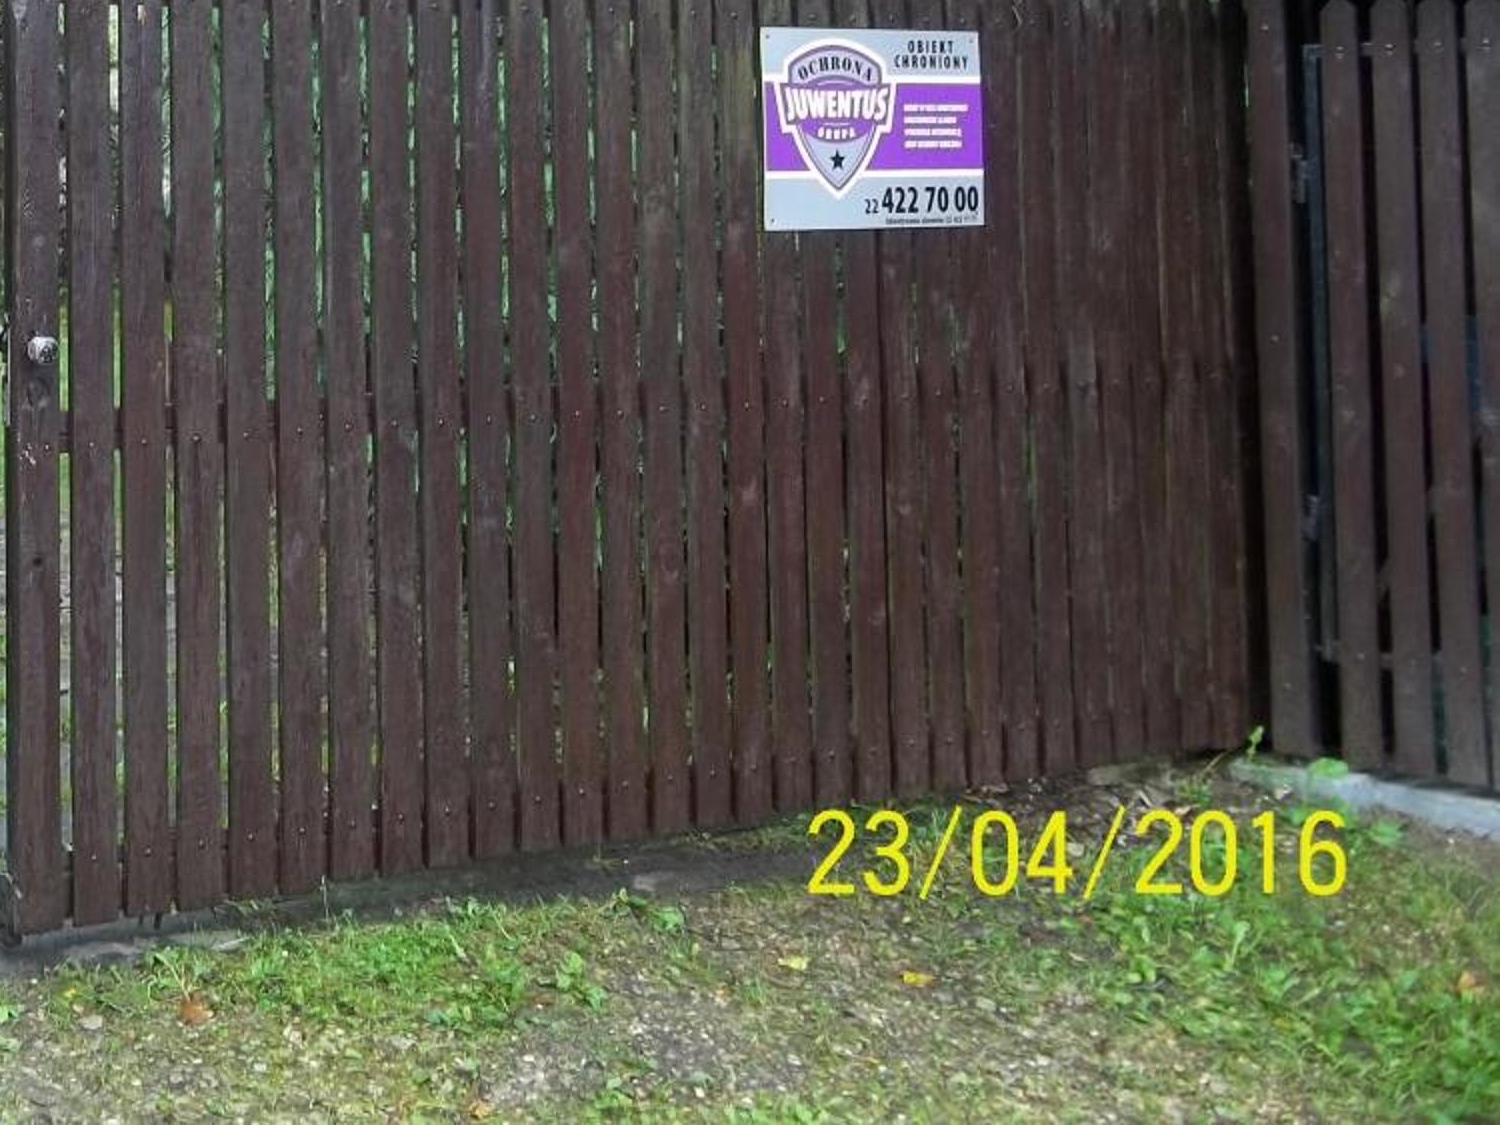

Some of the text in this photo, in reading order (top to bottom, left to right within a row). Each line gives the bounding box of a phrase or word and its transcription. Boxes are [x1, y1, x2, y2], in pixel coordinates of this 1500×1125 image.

[907, 40, 954, 54] OBIEKT
[797, 55, 873, 82] OCHRONA
[894, 55, 968, 70] CHRONIONY
[784, 86, 889, 122] JUWENTUS
[864, 198, 879, 214] 22
[882, 186, 919, 214] 422
